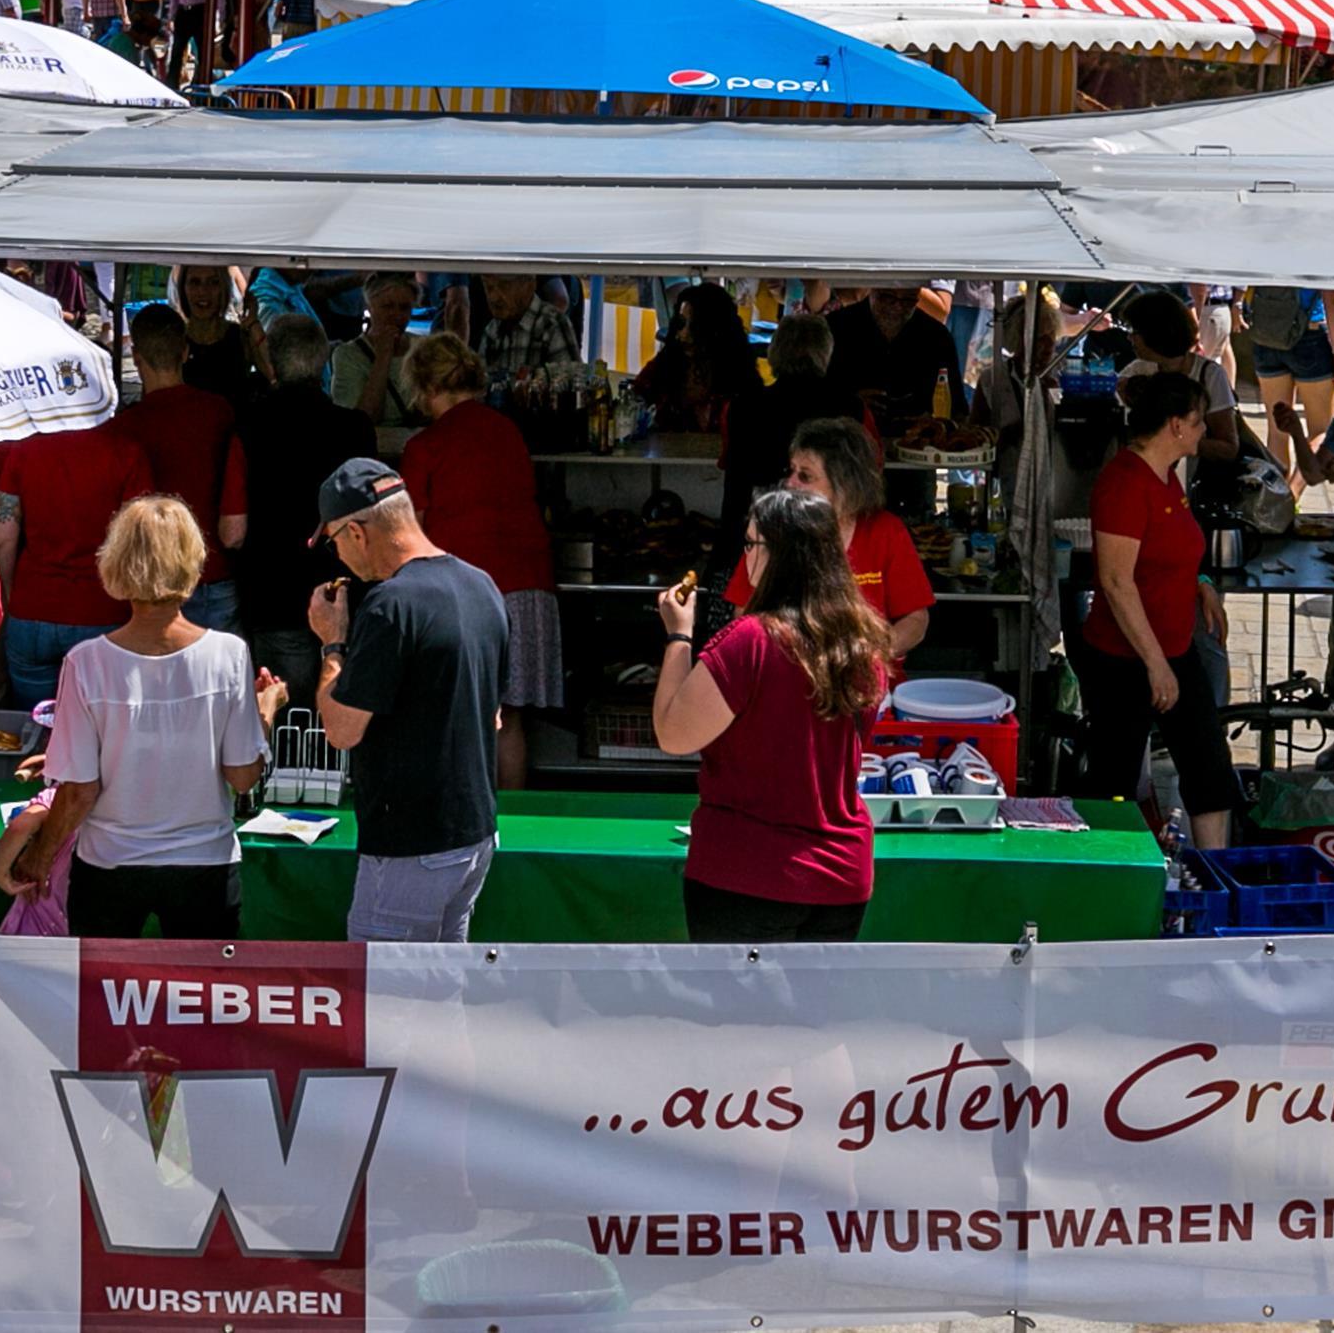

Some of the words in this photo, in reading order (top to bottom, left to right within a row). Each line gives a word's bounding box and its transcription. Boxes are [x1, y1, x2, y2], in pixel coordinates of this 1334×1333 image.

[725, 74, 831, 94] pepsi
[101, 978, 343, 1027] WEBER
[583, 1085, 805, 1135] ...aus
[836, 1042, 1070, 1152] gutem
[50, 1066, 398, 1259] W
[587, 1212, 806, 1257] WEBER
[826, 1200, 1254, 1254] WURSTWAREN
[105, 1286, 342, 1315] WURSTWAREN
